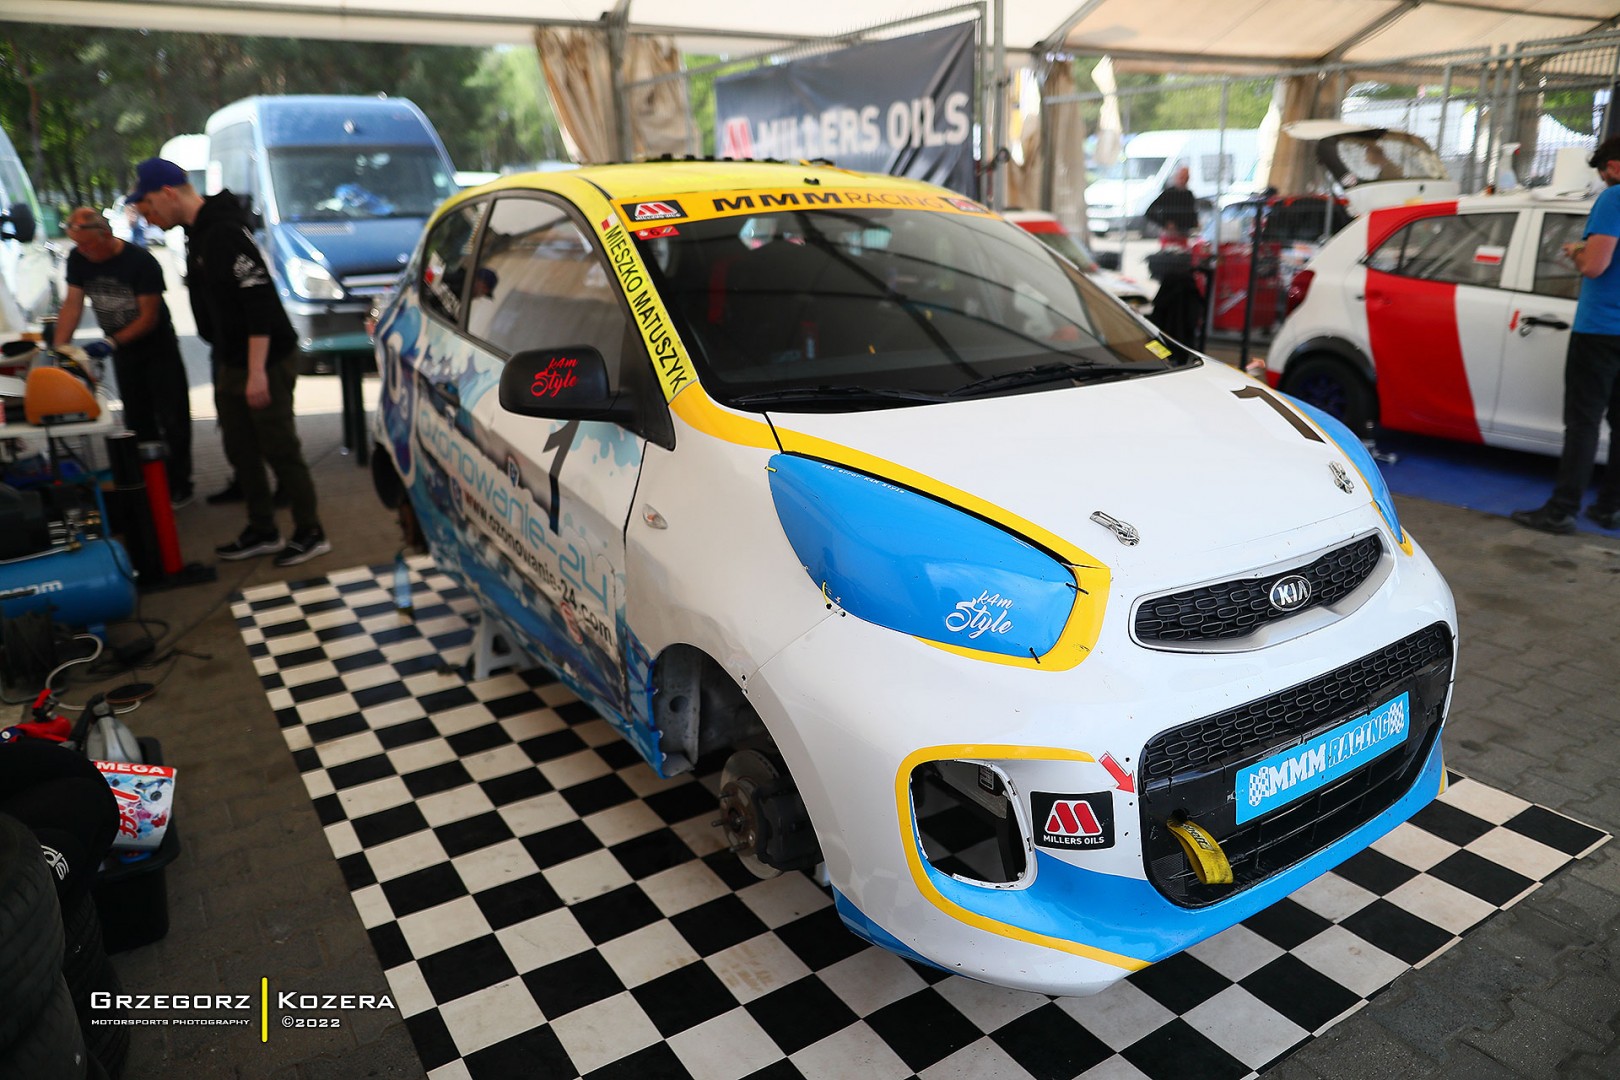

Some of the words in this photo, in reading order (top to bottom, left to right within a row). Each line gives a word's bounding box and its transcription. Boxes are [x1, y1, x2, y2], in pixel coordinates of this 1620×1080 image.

[757, 104, 881, 158] MILLERS
[886, 92, 971, 149] OILS
[844, 191, 944, 209] RACING
[604, 224, 644, 293] MIESZKO
[632, 290, 688, 394] MATUSZYK
[530, 368, 578, 398] Style
[543, 420, 580, 537] 1
[976, 589, 1014, 609] k4m
[945, 597, 1014, 639] Style
[96, 761, 165, 775] MEGA
[1268, 741, 1327, 797] MMM
[1328, 709, 1391, 768] RACING
[1043, 834, 1083, 845] MILLERS
[1084, 836, 1105, 845] OILS
